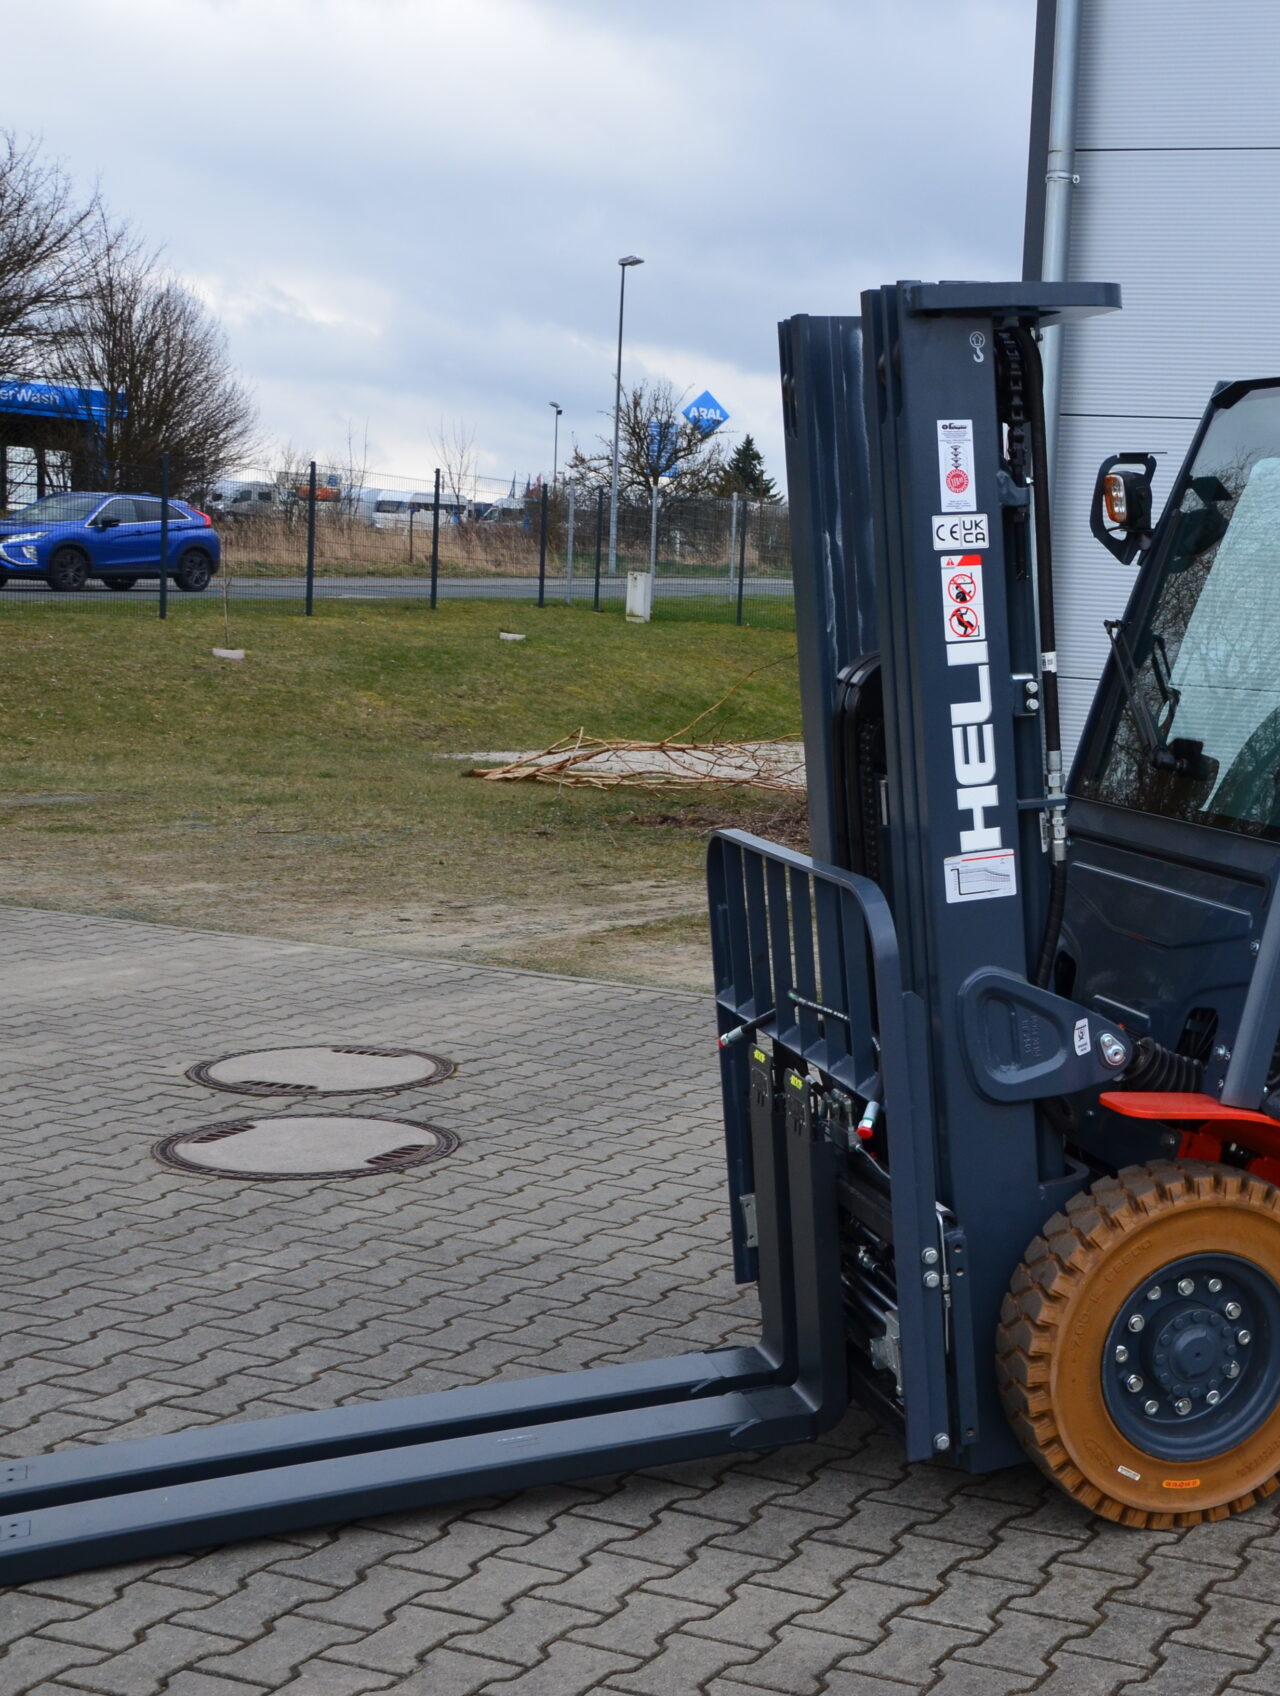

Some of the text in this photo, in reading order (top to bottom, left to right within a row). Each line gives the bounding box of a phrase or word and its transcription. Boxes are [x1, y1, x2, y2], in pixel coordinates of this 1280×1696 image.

[689, 407, 723, 420] ARAL
[962, 519, 984, 531] UK
[936, 523, 959, 541] CE
[963, 532, 985, 543] CA
[946, 641, 1002, 853] HELI
